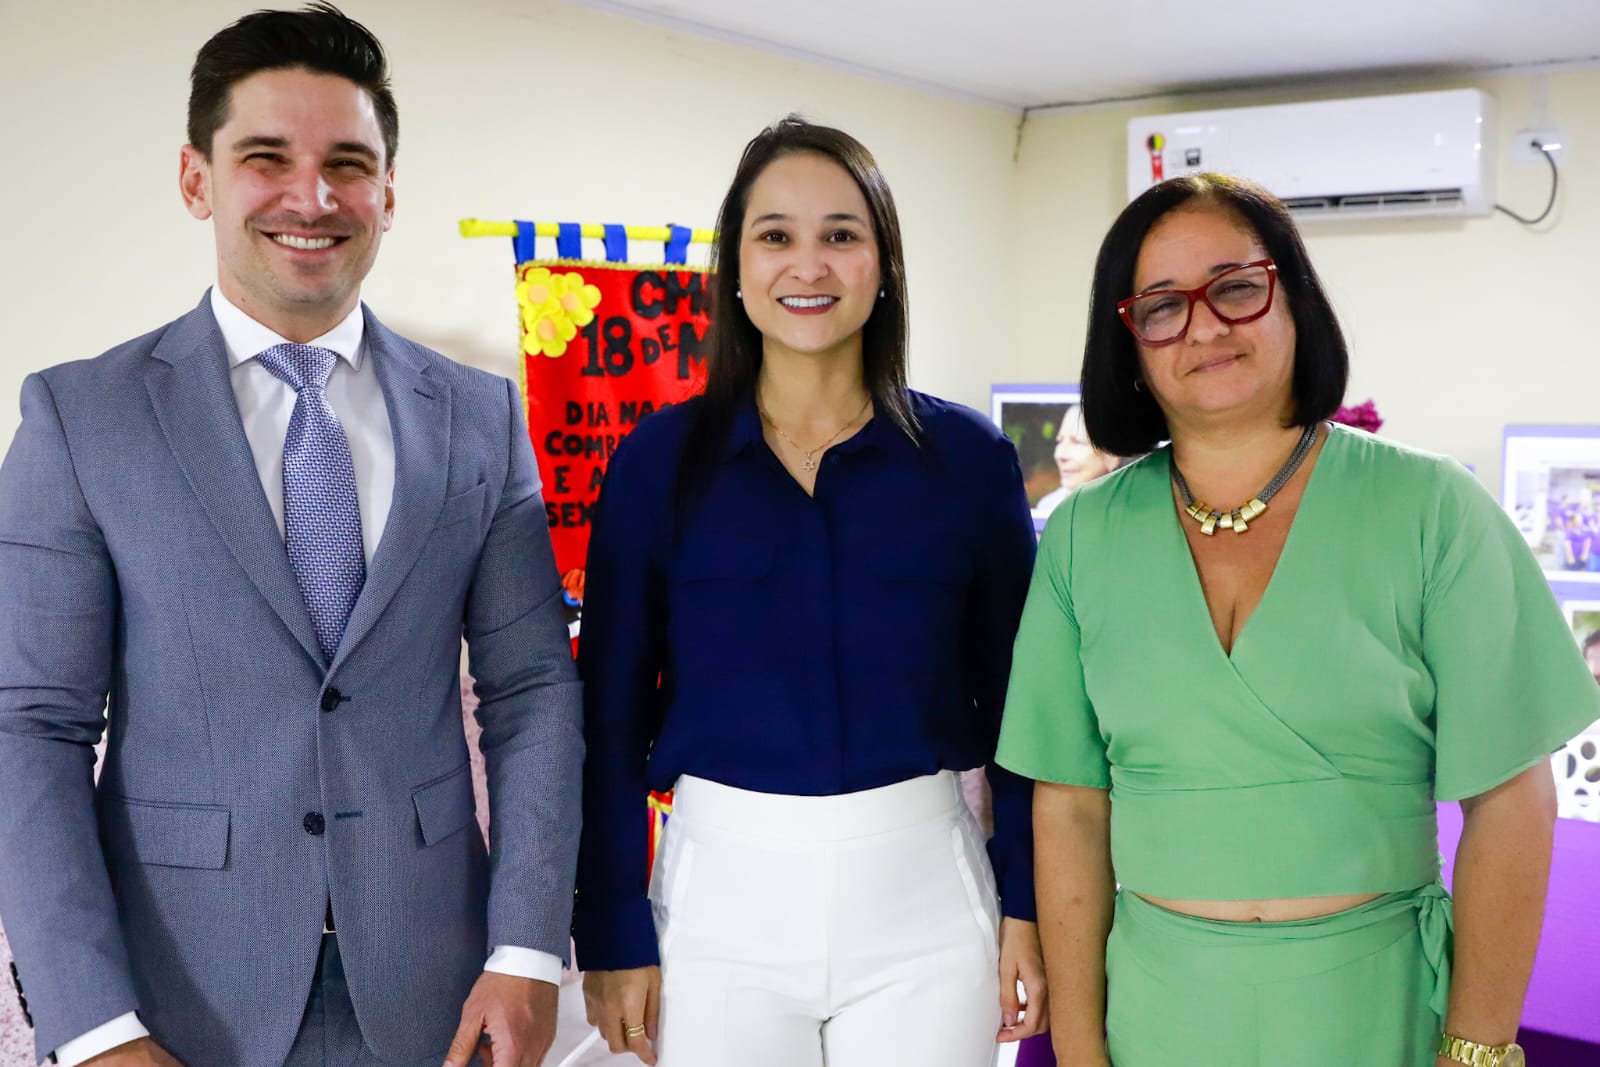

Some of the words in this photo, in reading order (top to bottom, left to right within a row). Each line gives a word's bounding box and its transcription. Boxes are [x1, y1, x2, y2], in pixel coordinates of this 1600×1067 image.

[632, 270, 711, 318] CM
[582, 315, 634, 376] 18
[642, 324, 677, 366] DE
[566, 401, 609, 427] DIA
[620, 400, 671, 424] NA
[545, 431, 626, 460] COMB
[555, 466, 570, 494] E
